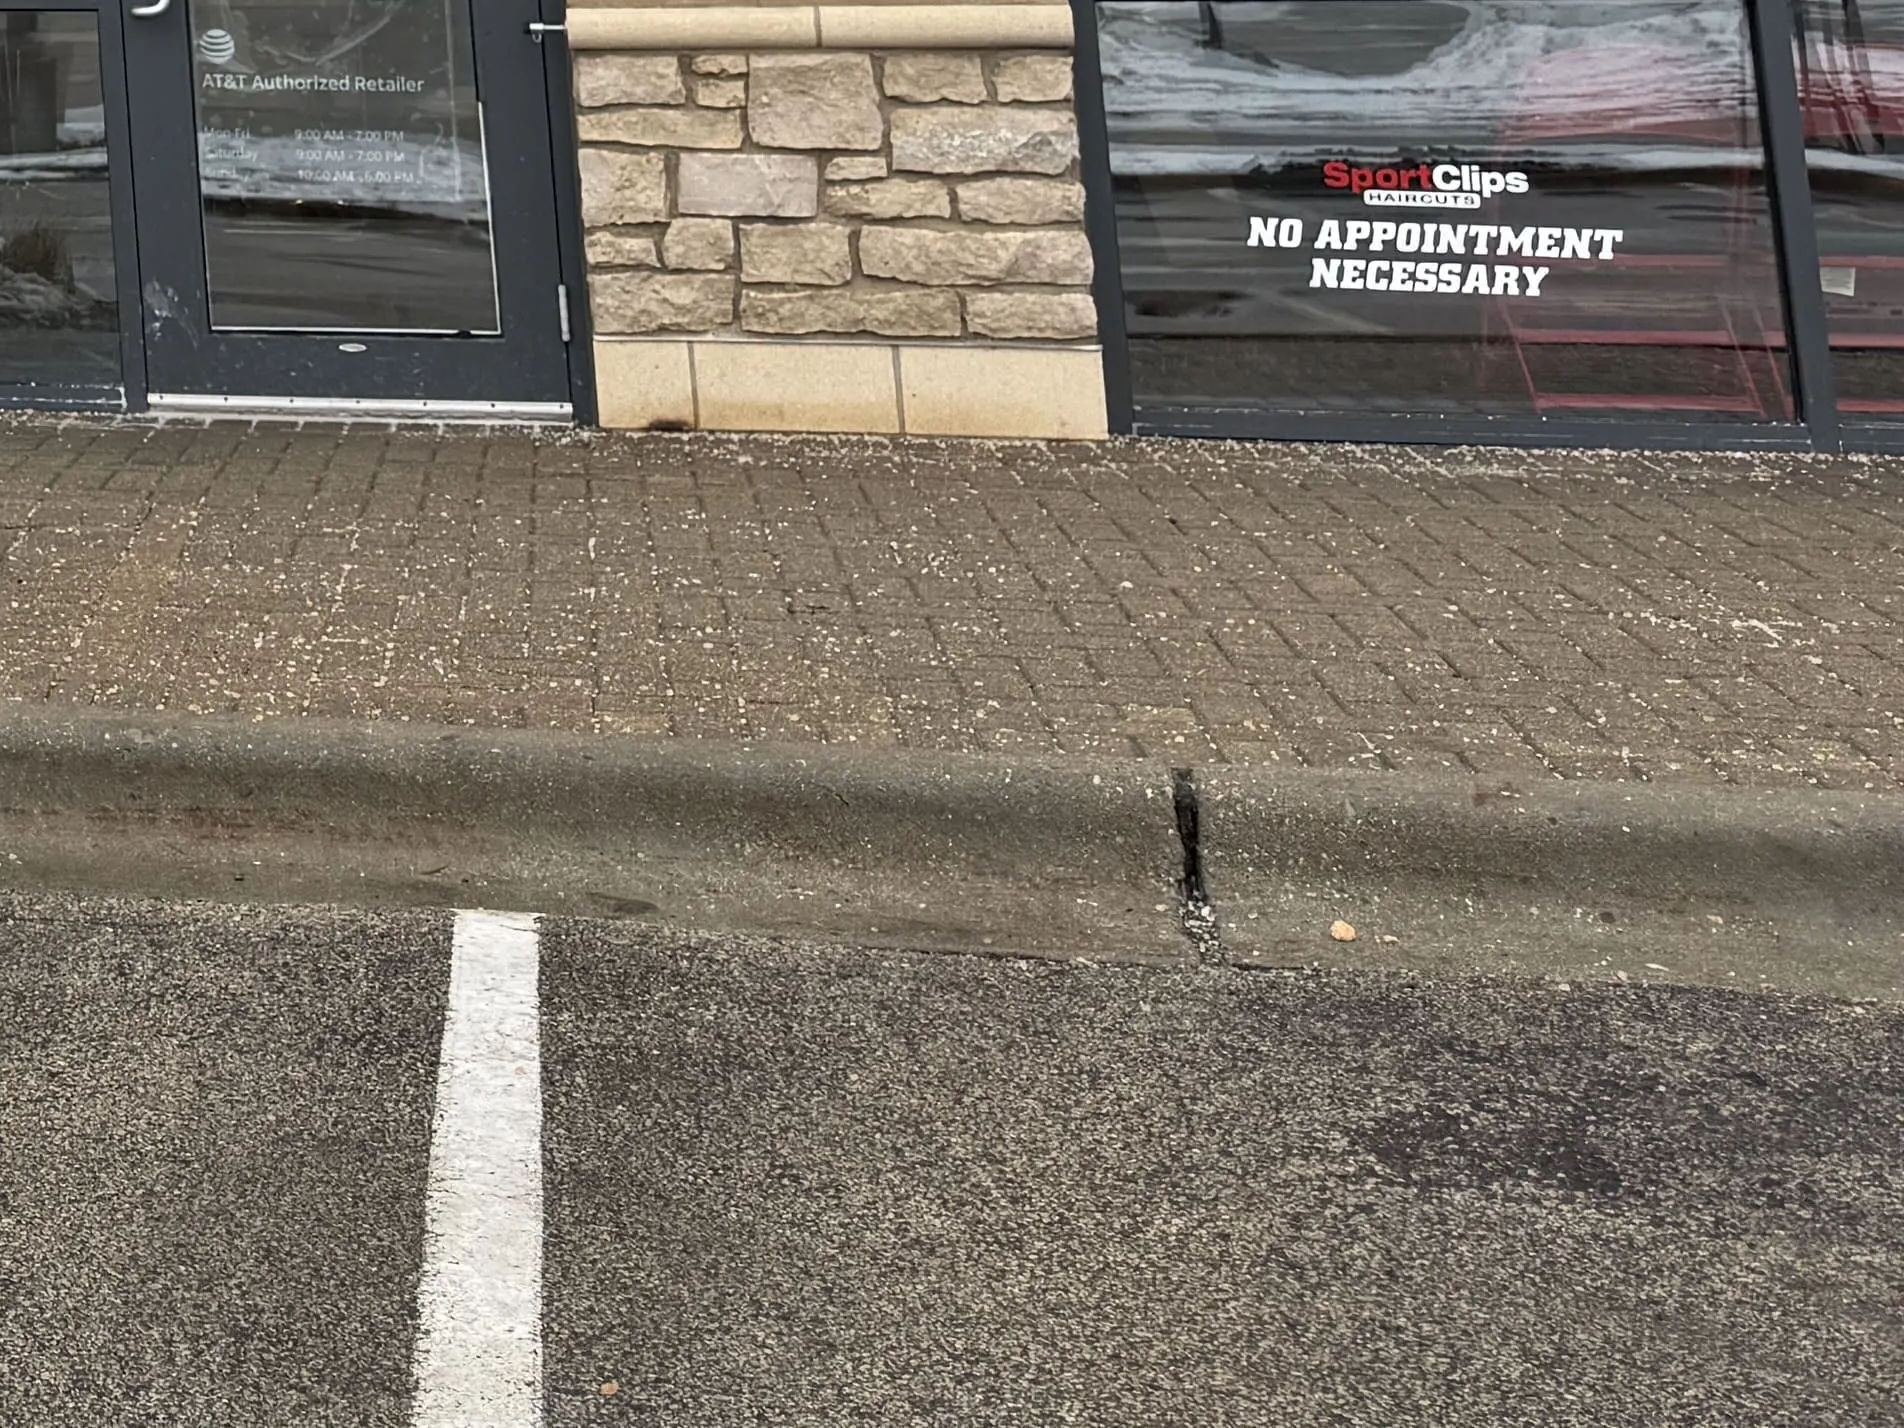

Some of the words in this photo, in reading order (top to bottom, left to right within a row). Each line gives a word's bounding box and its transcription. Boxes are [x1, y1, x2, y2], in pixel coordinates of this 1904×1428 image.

[202, 74, 246, 90] AT&T
[252, 74, 349, 91] Authorized
[354, 76, 424, 92] Retailer
[324, 150, 345, 161] AM
[1368, 192, 1475, 206] HAIRCUTS
[1246, 216, 1303, 247] NO
[1313, 218, 1624, 261] APPOINTMENT
[1309, 257, 1549, 296] NECESSARY
